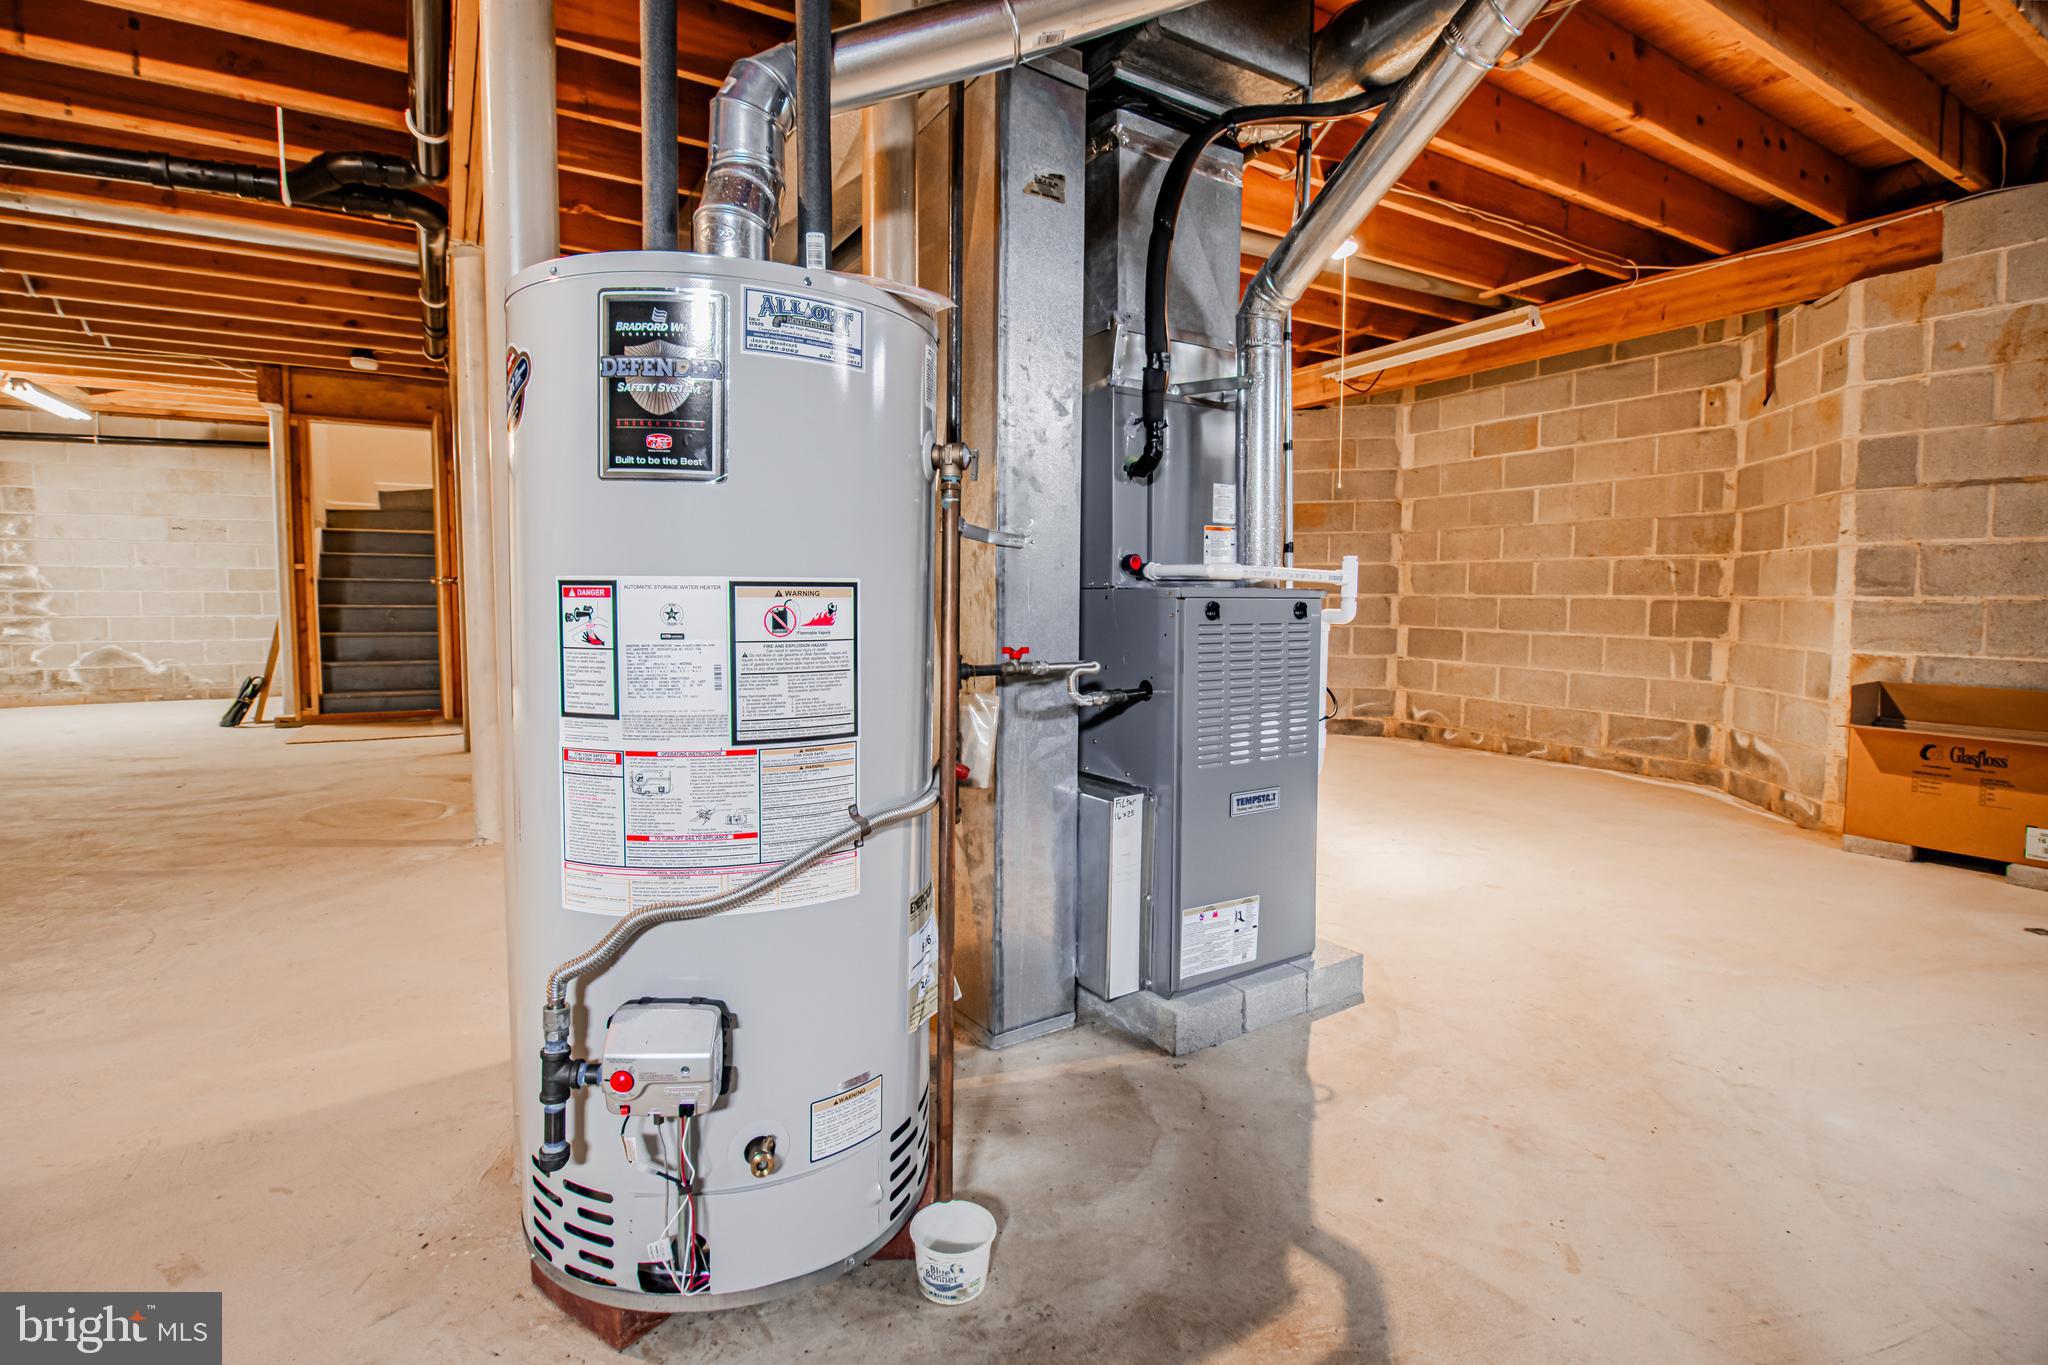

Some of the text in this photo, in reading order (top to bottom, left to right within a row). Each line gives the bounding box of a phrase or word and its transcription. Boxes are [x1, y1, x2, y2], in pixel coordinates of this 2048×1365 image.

[758, 295, 854, 337] ALL OUT
[615, 321, 669, 332] BRADFORD
[601, 356, 723, 380] DEFENDER
[617, 382, 701, 394] SAFETY SYSTEM
[616, 419, 661, 427] ENERGY
[615, 456, 634, 464] Built
[636, 456, 645, 464] to
[648, 456, 660, 464] be
[662, 457, 678, 465] the
[1950, 746, 2009, 769] Glasfloss
[839, 1088, 866, 1103] WARNING
[925, 1269, 960, 1283] Bonnet
[930, 1265, 950, 1277] Blue
